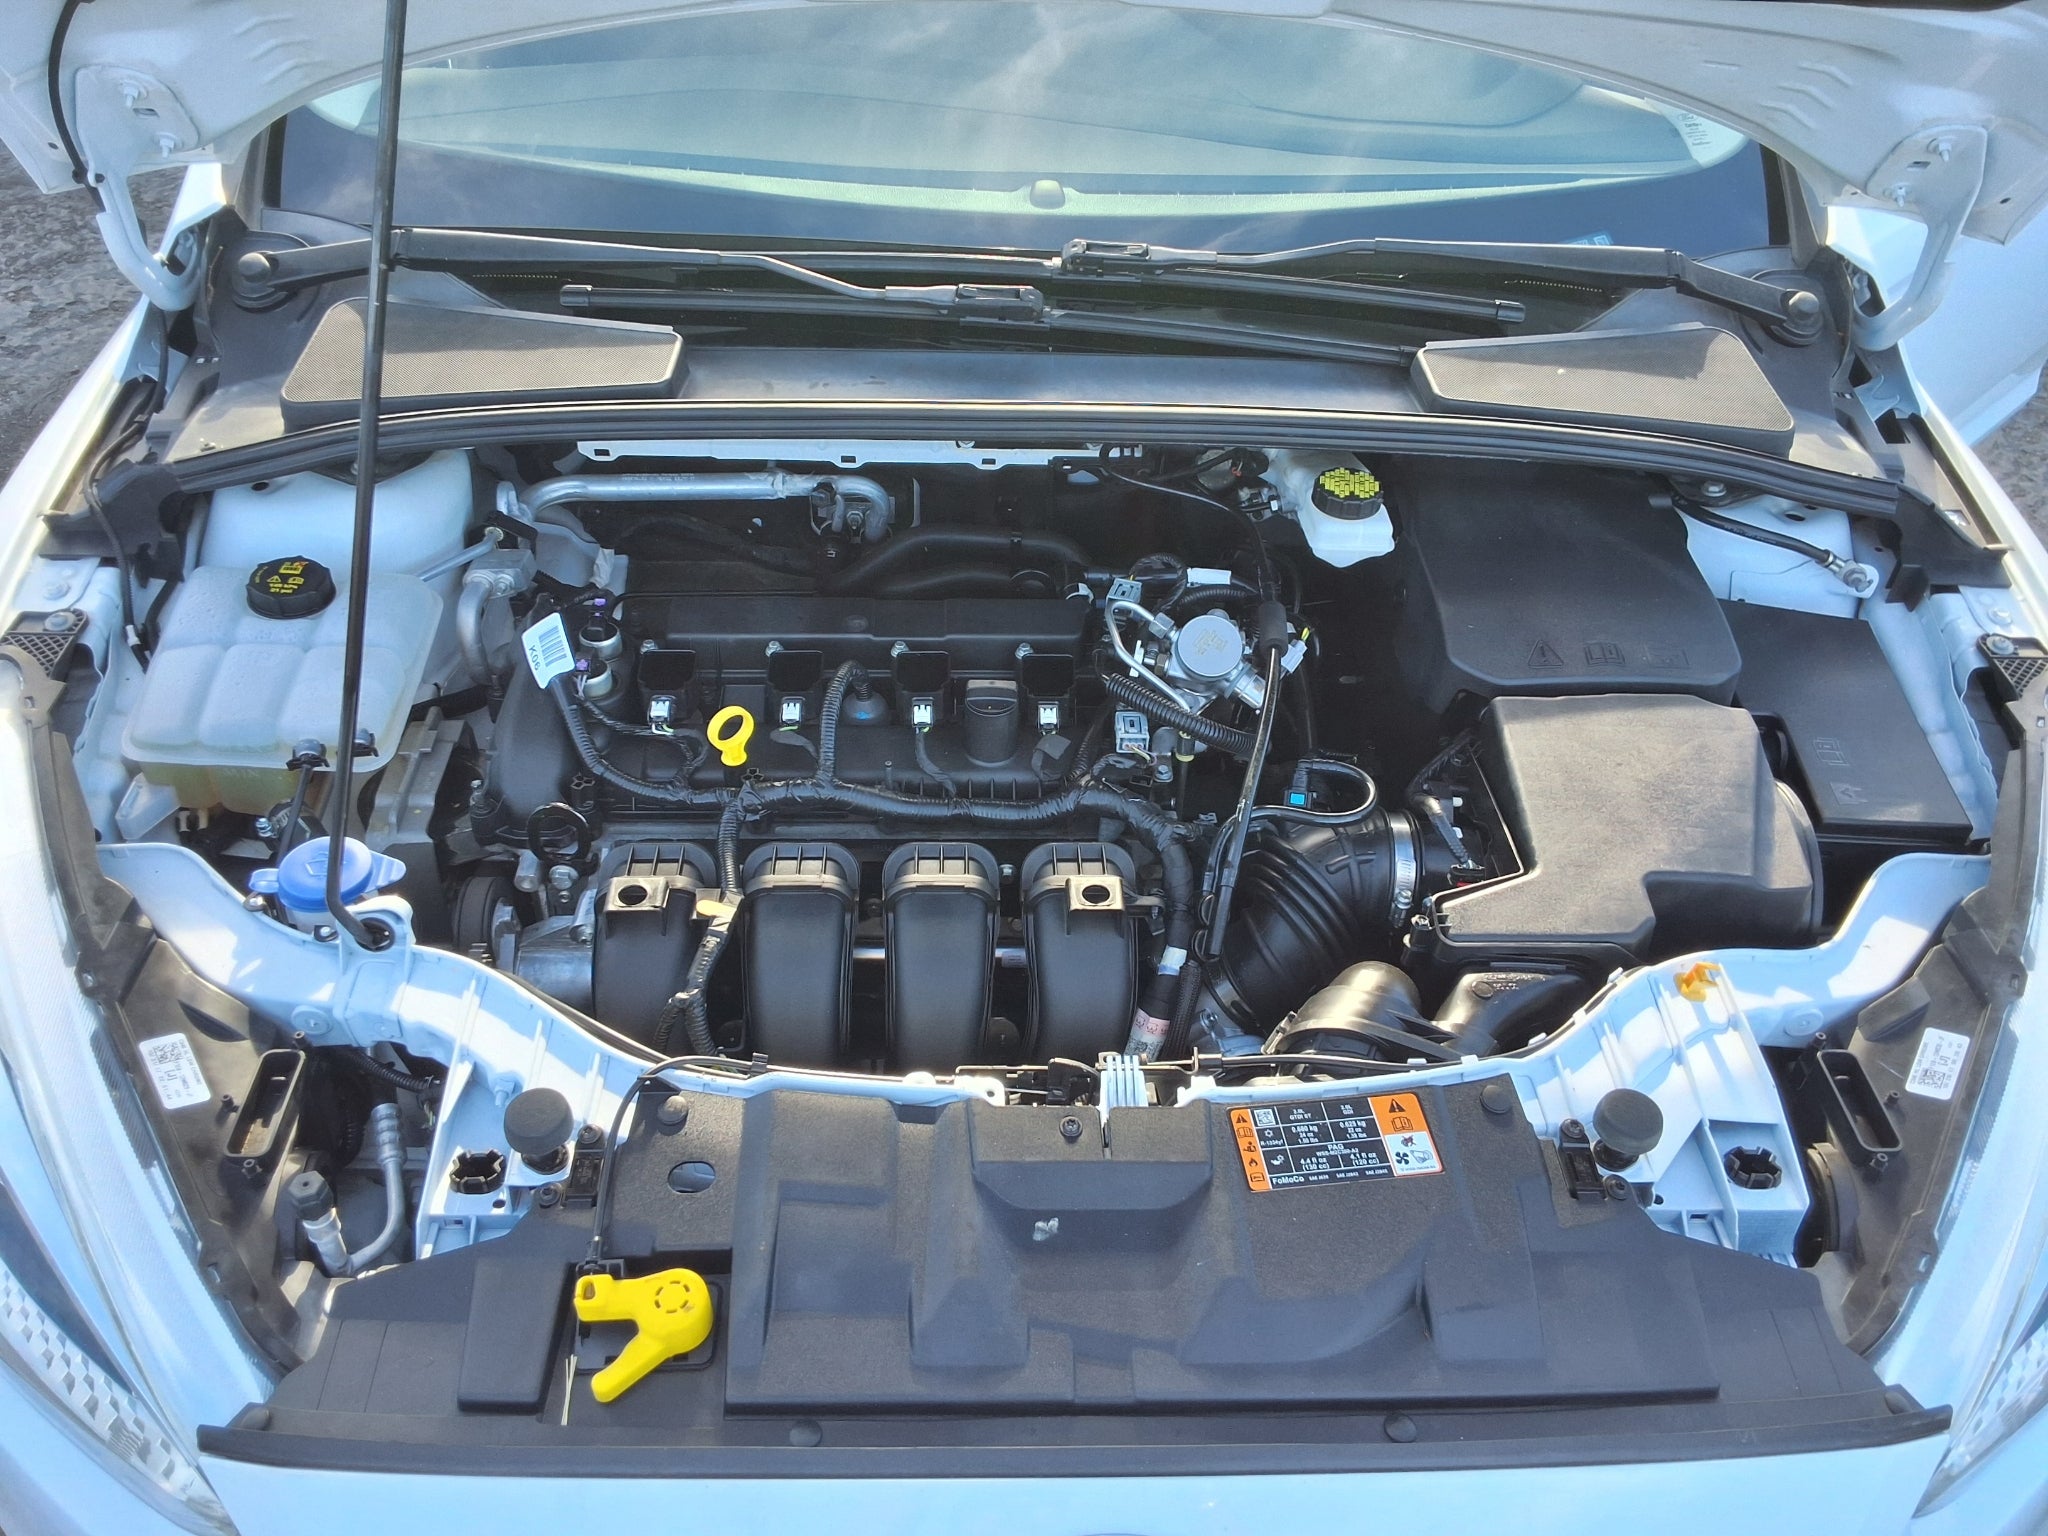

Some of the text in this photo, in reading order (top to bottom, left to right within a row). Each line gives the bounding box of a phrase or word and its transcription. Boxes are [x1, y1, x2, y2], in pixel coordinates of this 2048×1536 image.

[528, 644, 541, 671] K06
[1357, 1120, 1367, 1128] kg
[1327, 1143, 1345, 1151] PAG
[1350, 1152, 1360, 1160] 4.1
[1300, 1157, 1311, 1165] 4.4
[1352, 1159, 1367, 1167] (120
[1302, 1163, 1317, 1171] (130
[1271, 1175, 1305, 1185] FoMoCo
